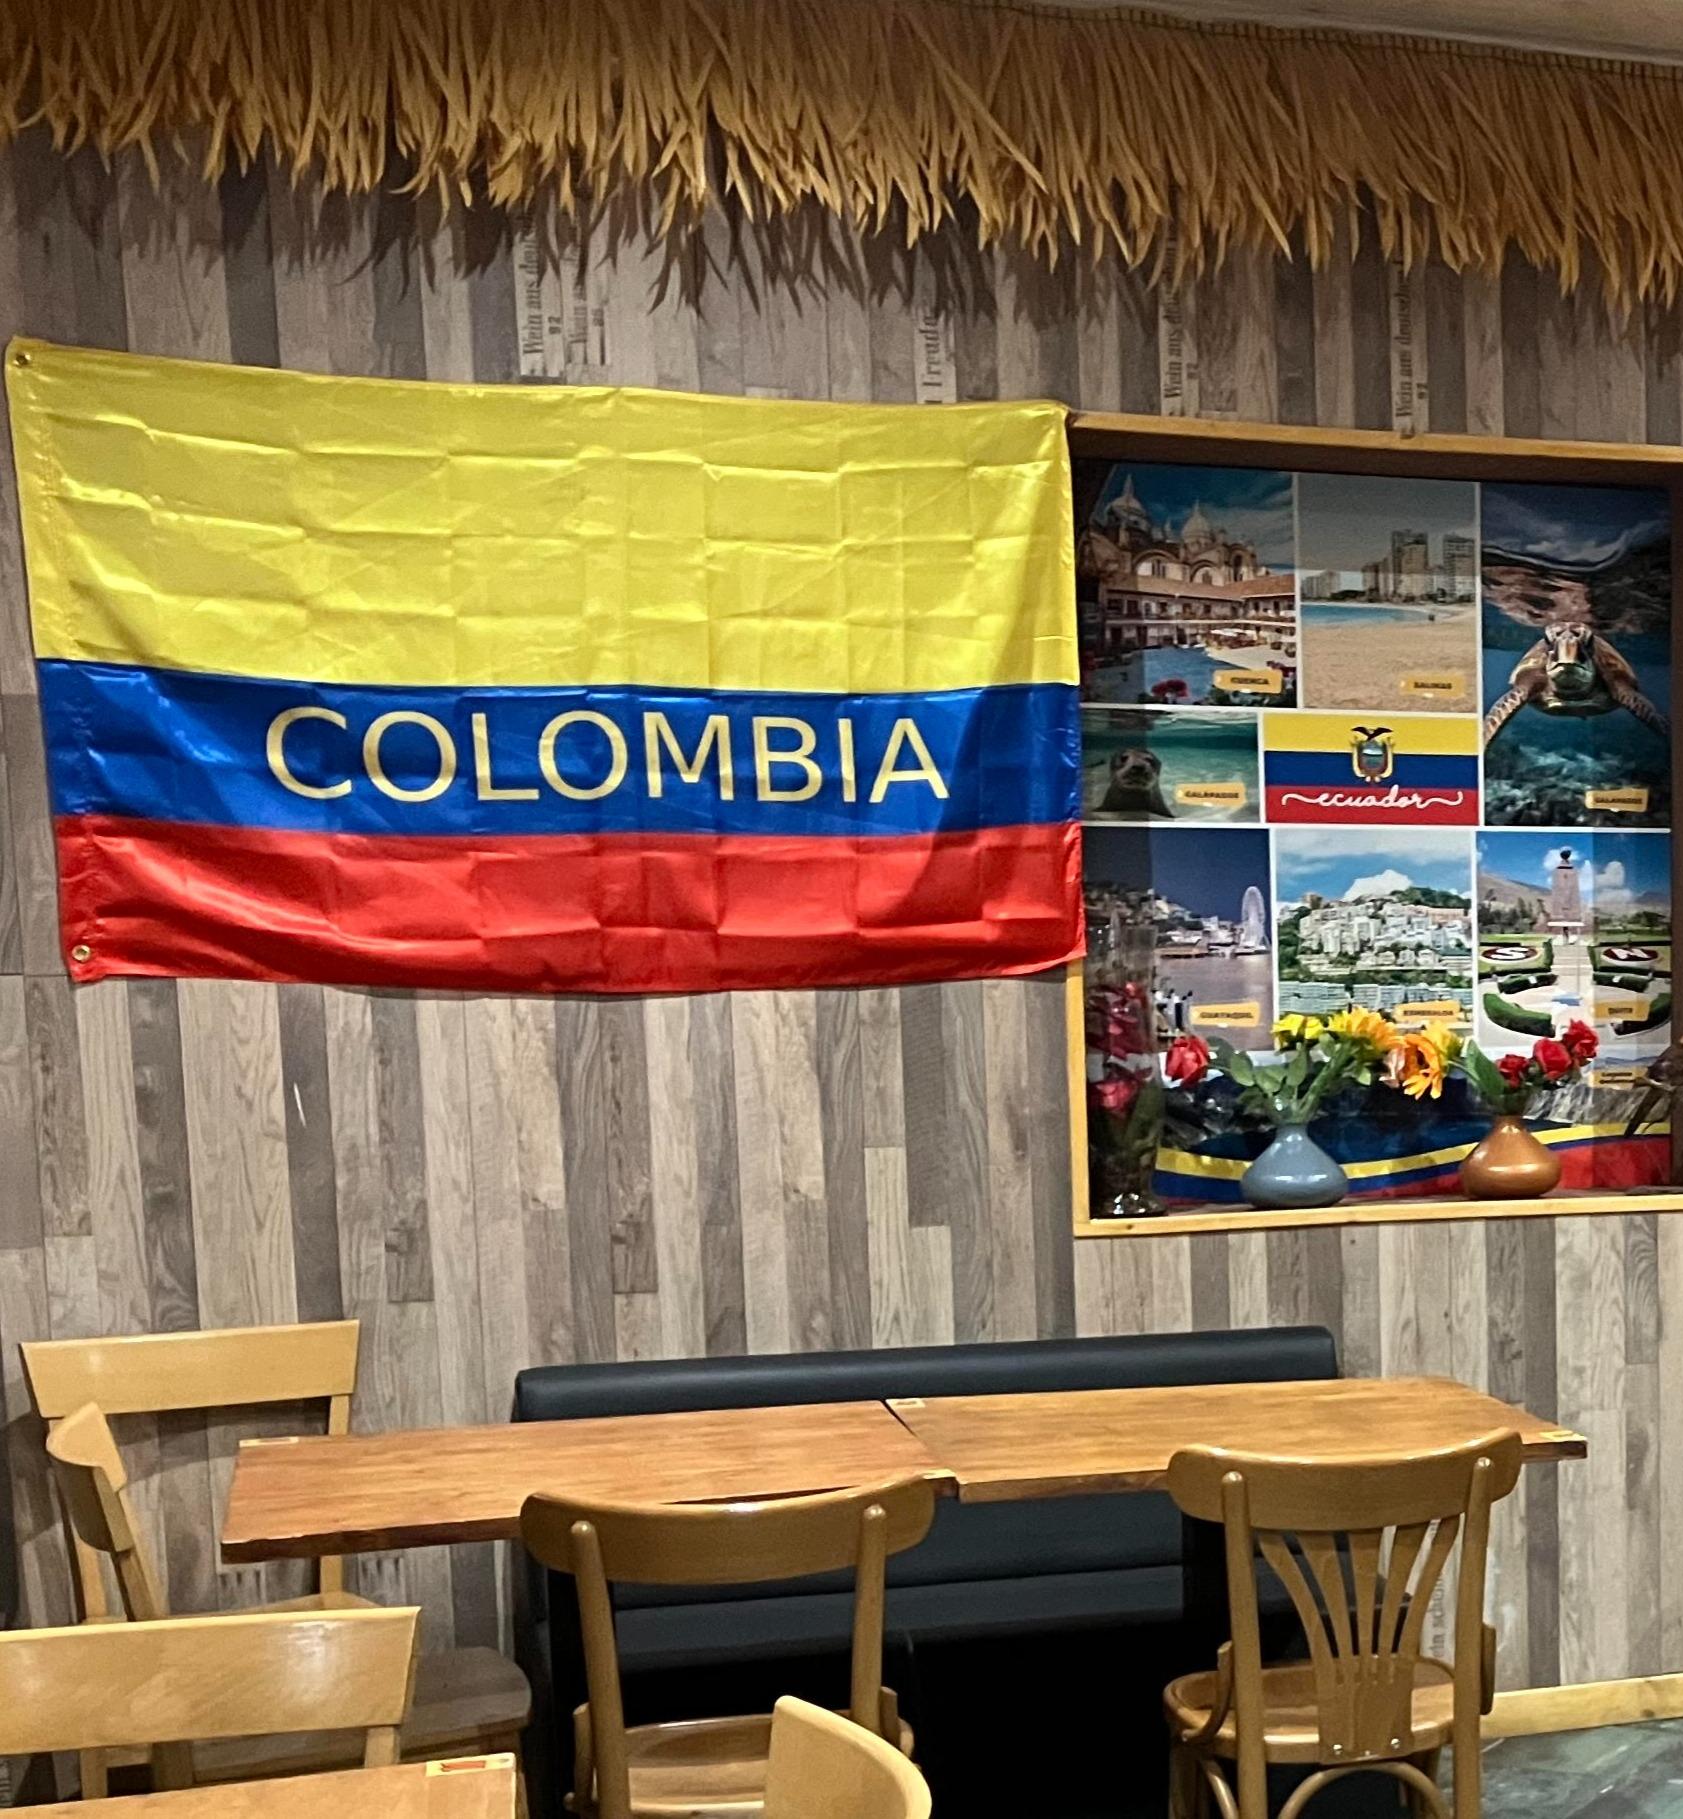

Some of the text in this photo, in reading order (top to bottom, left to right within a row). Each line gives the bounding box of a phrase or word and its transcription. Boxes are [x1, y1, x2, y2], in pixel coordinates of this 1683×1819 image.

[526, 281, 543, 311] aus
[522, 314, 544, 355] Wein
[547, 316, 562, 336] 92
[1167, 328, 1183, 357] aus
[1399, 350, 1413, 377] aus
[1163, 361, 1183, 398] Wein
[1395, 381, 1413, 417] Wein
[1230, 676, 1270, 685] CUENCA
[1413, 681, 1453, 690] SALINAS
[266, 706, 950, 803] COLOMBIA
[1282, 784, 1464, 810] ecuador
[1489, 946, 1529, 961] S
[1609, 947, 1649, 960] N
[1429, 1633, 1445, 1658] ein
